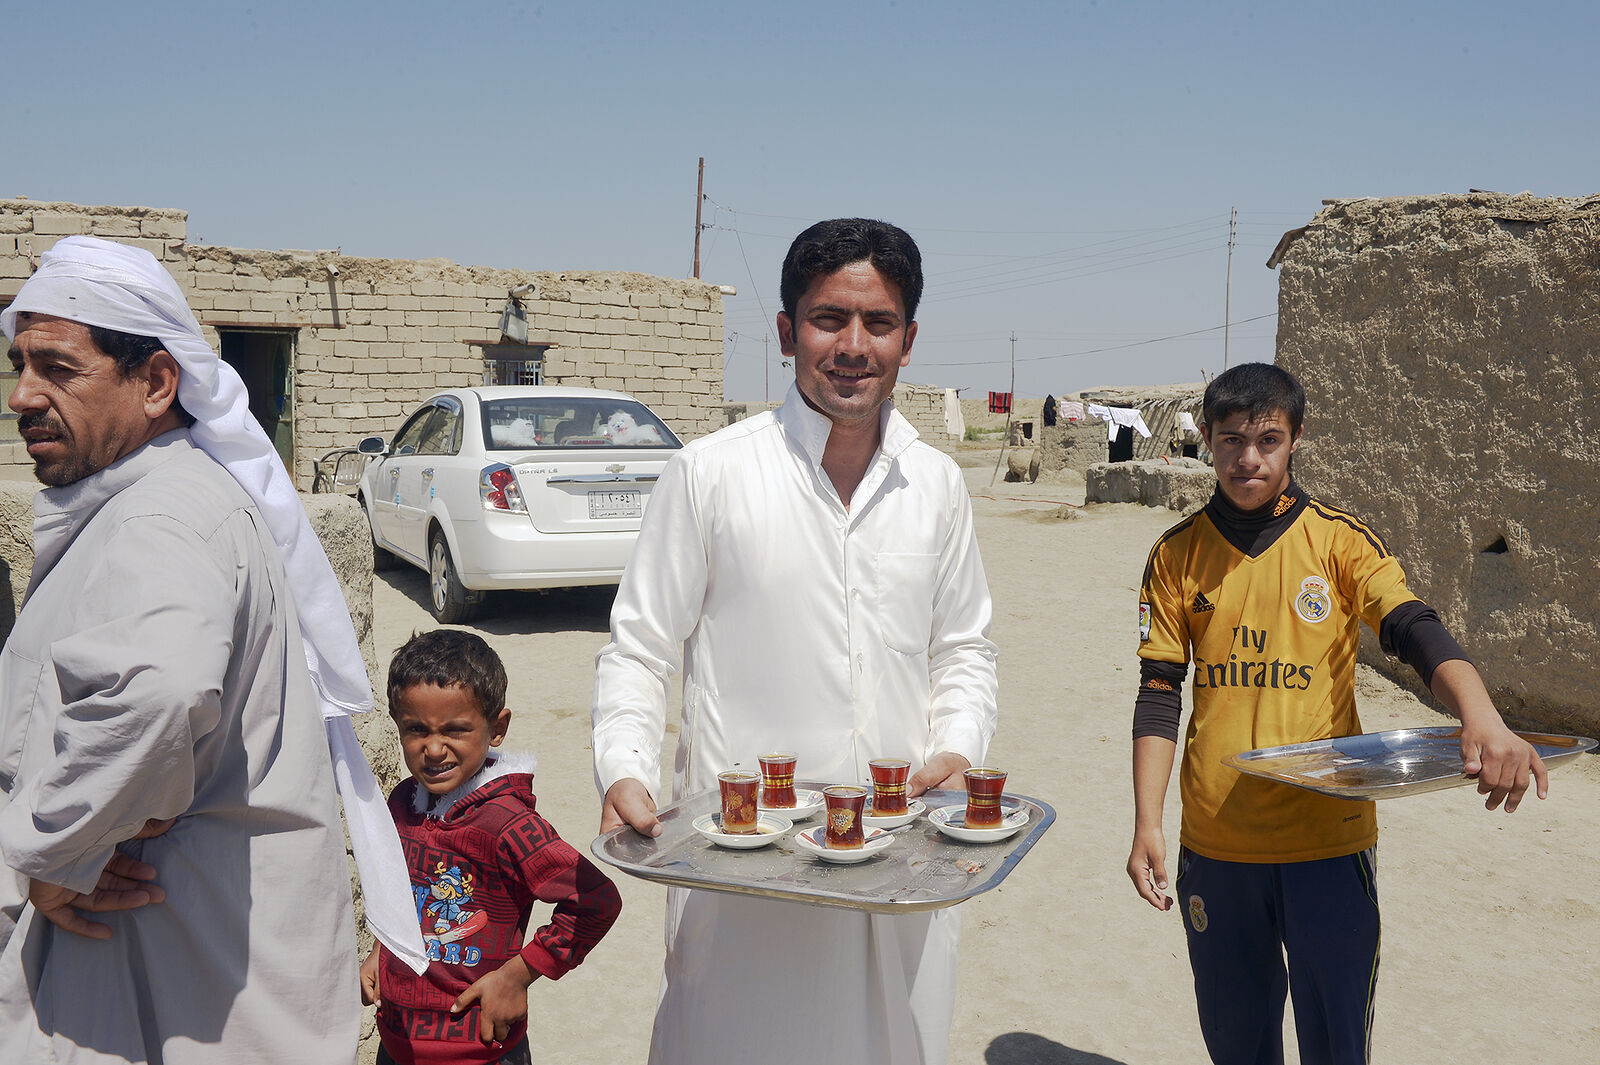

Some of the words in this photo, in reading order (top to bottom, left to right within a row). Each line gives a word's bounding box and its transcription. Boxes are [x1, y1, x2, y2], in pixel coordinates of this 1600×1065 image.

[1273, 496, 1297, 517] adidas
[1192, 603, 1216, 614] adidas
[422, 938, 482, 967] ARD
